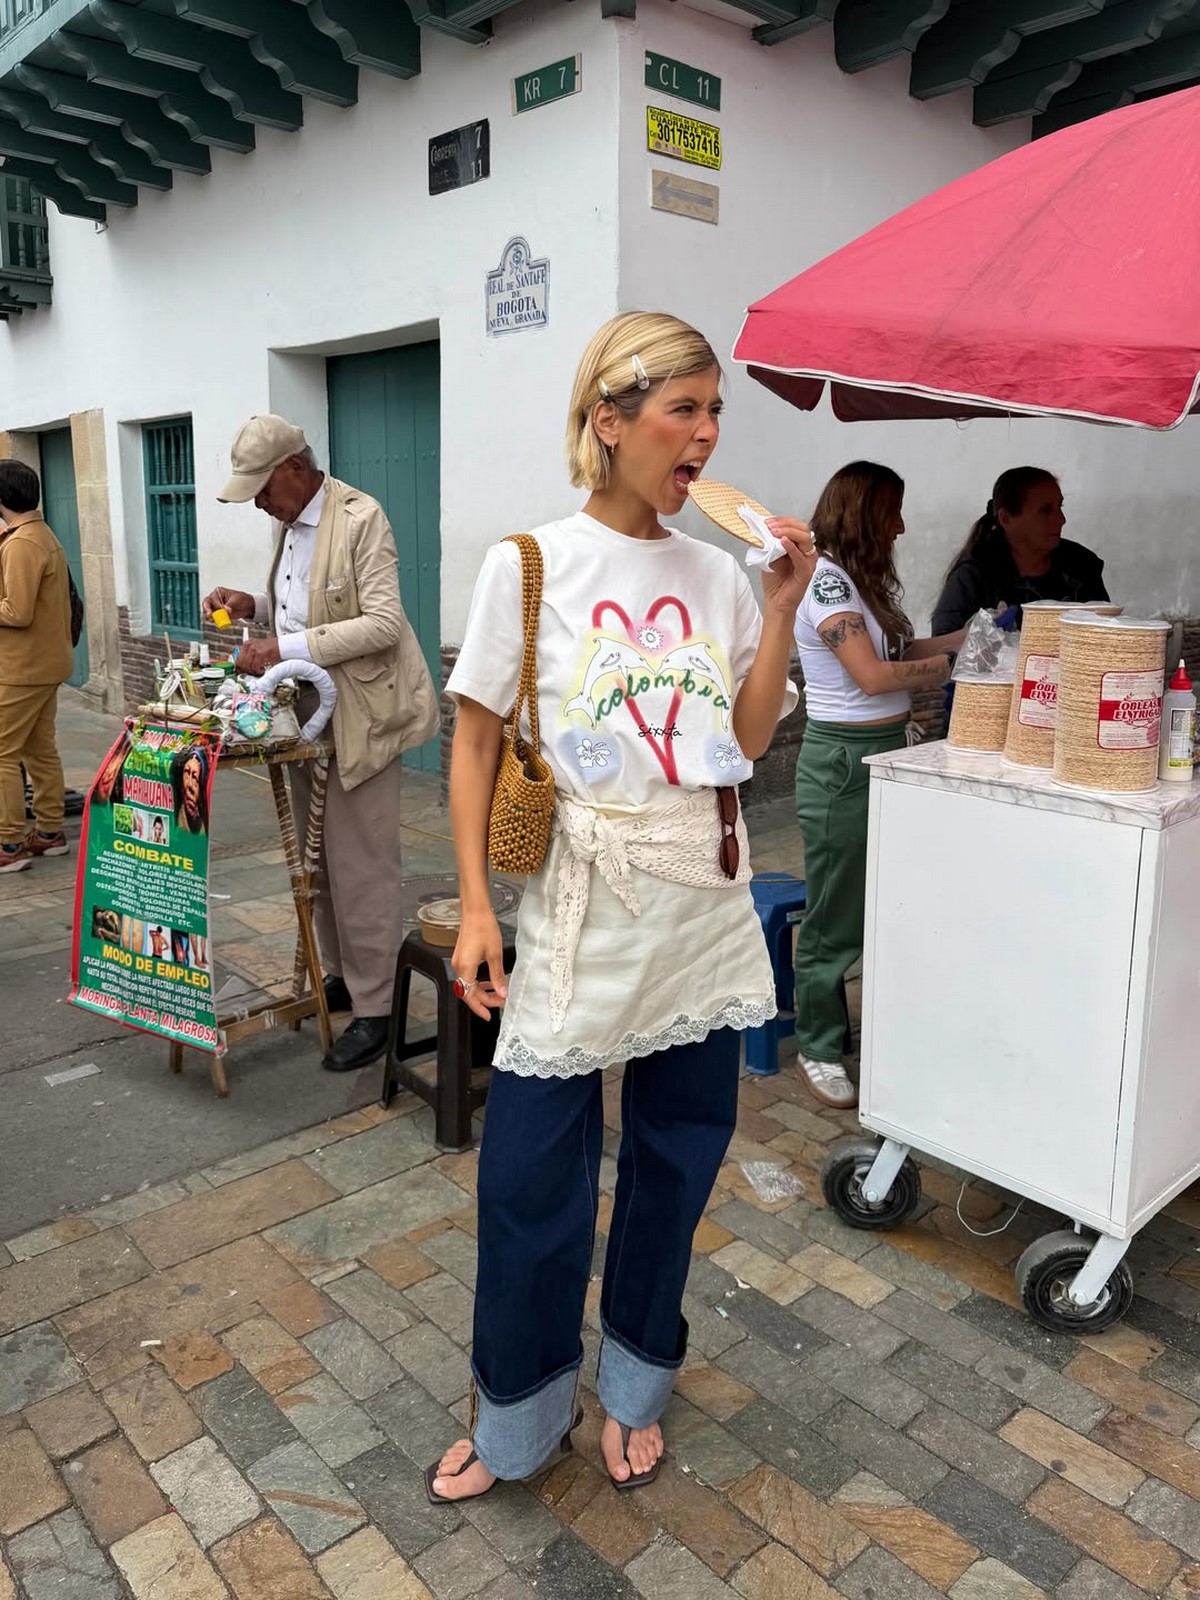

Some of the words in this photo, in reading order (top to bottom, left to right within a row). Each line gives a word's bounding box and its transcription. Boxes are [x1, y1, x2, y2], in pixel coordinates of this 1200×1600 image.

[523, 77, 541, 102] KR
[558, 66, 566, 90] 7
[660, 63, 679, 90] CL
[697, 76, 710, 100] 11
[650, 113, 699, 134] CUADRANTE
[474, 126, 482, 149] 7
[657, 122, 720, 157] 3017537416
[470, 159, 482, 179] 11
[511, 289, 521, 299] DE
[497, 296, 537, 317] BOGOTA
[113, 840, 194, 871] COMBATE
[140, 896, 171, 908] DOLORES
[178, 919, 194, 929] ETC.
[102, 944, 133, 967] MODO
[135, 956, 153, 974] DE
[156, 962, 210, 989] EMPLEO
[79, 987, 121, 1010] MORINGA
[122, 1001, 159, 1024] PLANTA
[161, 1013, 217, 1044] MILAGROSA
